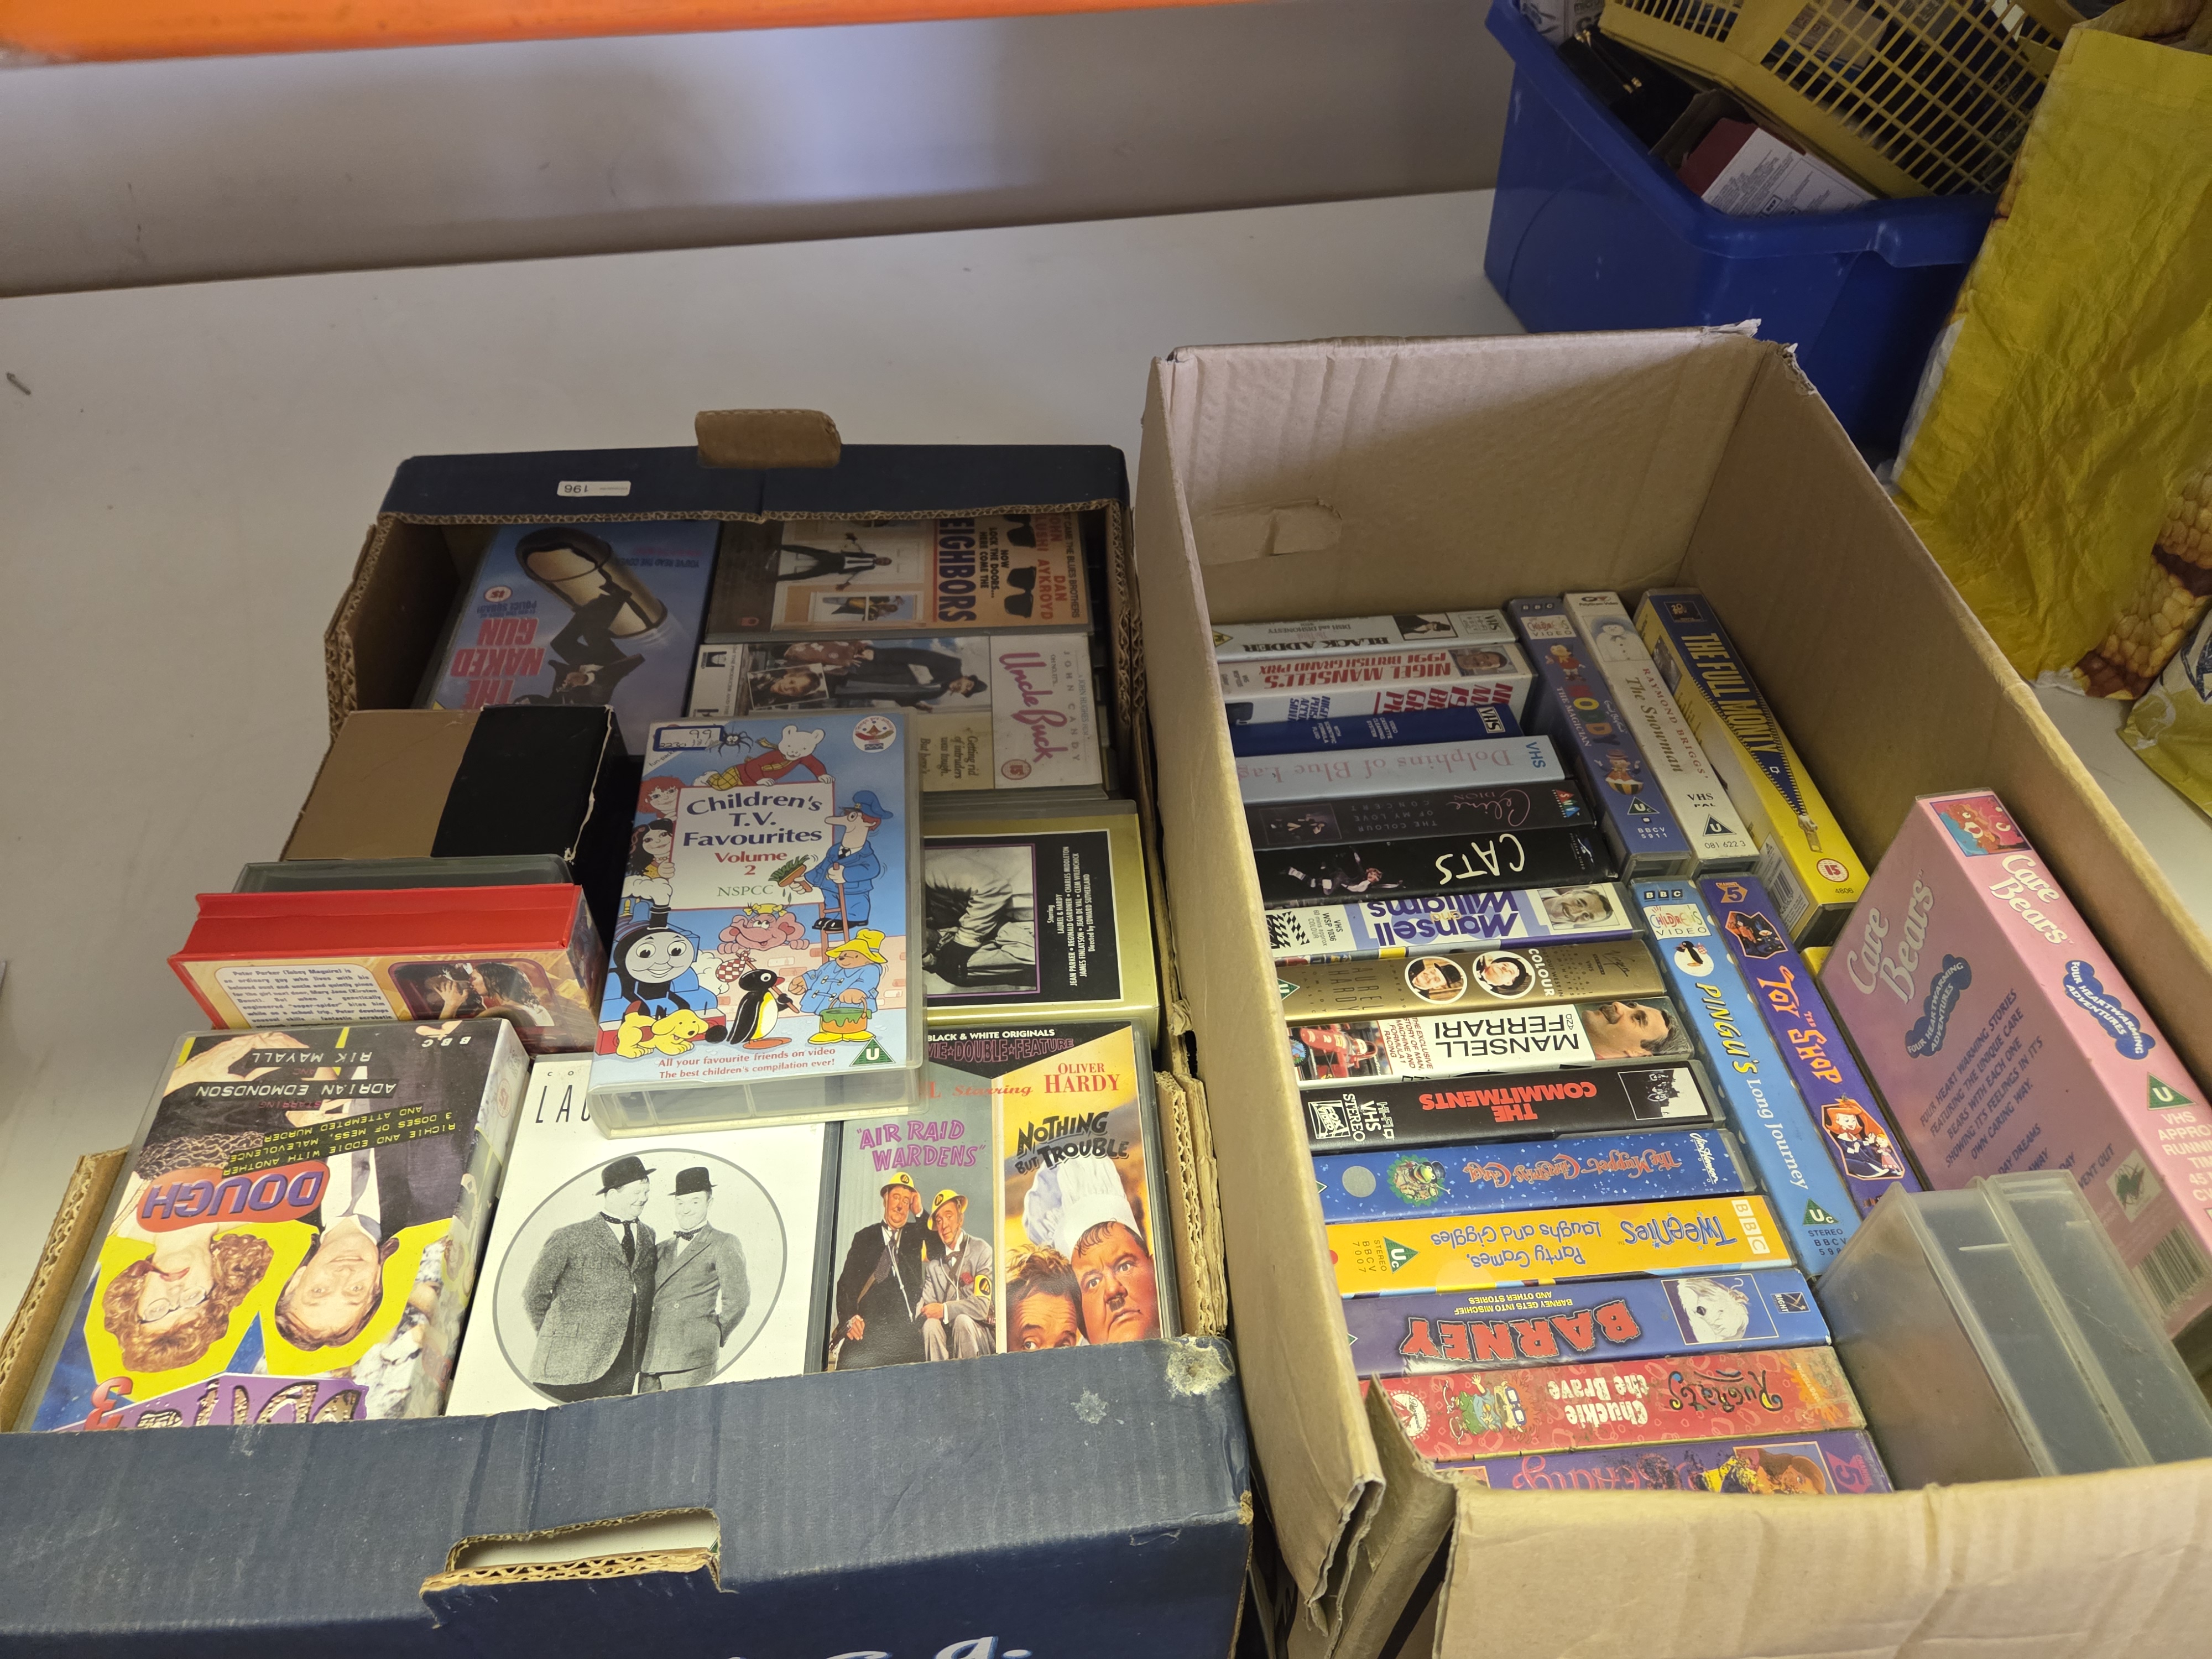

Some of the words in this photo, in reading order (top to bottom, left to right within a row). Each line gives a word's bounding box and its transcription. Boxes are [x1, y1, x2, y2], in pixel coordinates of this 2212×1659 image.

[564, 484, 588, 493] 196
[979, 531, 988, 549] HERE
[980, 551, 989, 572] COME
[1000, 549, 1010, 568] NOW
[938, 518, 977, 622] EIGHBORS
[1037, 559, 1053, 620] AYKROYD
[1053, 575, 1067, 602] DAN
[477, 617, 540, 646] GUN
[1241, 640, 1317, 652] ADDER
[1322, 637, 1390, 649] BLACK
[1681, 633, 1731, 660] THE
[450, 646, 546, 677] NAKED
[1294, 659, 1343, 672] GRAND
[1346, 655, 1402, 667] BRITISH
[1407, 653, 1447, 663] 1991
[999, 652, 1053, 707] Uncle
[1063, 650, 1074, 692] JOHN
[1259, 664, 1291, 675] PRIX
[1264, 666, 1383, 689] MANSELL'S
[1392, 662, 1451, 680] NIGEL
[1695, 662, 1751, 698] FULL
[1642, 667, 1678, 724] RAYMOND
[1389, 720, 1398, 734] VIDEO
[1556, 687, 1570, 705] THE
[1564, 705, 1592, 747] MAGICIAN
[1625, 677, 1646, 701] The
[1640, 704, 1684, 774] Snowman
[1717, 699, 1782, 753] MONTY
[1010, 709, 1068, 763] Buck
[1068, 703, 1081, 761] CANDY
[1380, 717, 1393, 740] CASSETTE
[1364, 755, 1388, 772] of
[1396, 747, 1515, 774] Dolphins
[1525, 740, 1546, 769] VHS
[1294, 760, 1352, 784] Blue
[686, 791, 823, 817] Children's
[1445, 788, 1531, 828] Celine
[728, 811, 777, 827] T.V.
[682, 829, 823, 847] Favourites
[714, 852, 788, 864] Volume
[1062, 846, 1071, 873] MIDDLETON
[1434, 833, 1525, 886] CATS
[743, 864, 757, 876] 2
[2002, 854, 2060, 904] Care
[717, 885, 775, 898] NSPCC
[1064, 873, 1072, 893] CHARLES
[1367, 891, 1519, 917] Williams
[1646, 891, 1682, 899] BBC
[1065, 897, 1074, 922] GARDINER
[1322, 912, 1333, 928] WSP
[1987, 877, 2069, 945] Bears
[1067, 922, 1076, 947] REGINALD
[1307, 918, 1319, 939] COLOUR
[1327, 928, 1337, 942] 1036
[1333, 920, 1344, 933] VHS
[1374, 912, 1519, 947] Mansell
[1656, 926, 1707, 936] VIDEO
[1847, 907, 1890, 995] Care
[1880, 883, 1934, 1004] Bears
[1068, 951, 1077, 973] PARKER
[1528, 948, 1556, 997] COLOUR
[1070, 972, 1078, 987] JEAN
[1328, 970, 1360, 1011] HARDY
[1930, 983, 1954, 1052] ADVENTURES
[2065, 983, 2127, 1035] ADVENTURES
[2070, 961, 2083, 985] FOUR
[2078, 984, 2145, 1055] HEARTWARMING
[1411, 1016, 1421, 1030] THE
[1435, 1014, 1568, 1040] FERRARI
[927, 1033, 957, 1042] BLACK
[969, 1031, 1000, 1040] WHITE
[1001, 1029, 1055, 1039] ORIGINALS
[1383, 1029, 1397, 1058] RACING
[1395, 1019, 1410, 1050] MACHINE
[1406, 1050, 1416, 1069] AND
[1436, 1033, 1580, 1058] MANSELL
[252, 1052, 324, 1063] MAYALL
[335, 1051, 373, 1062] RIK
[658, 1058, 673, 1067] All
[676, 1057, 700, 1069] your
[703, 1054, 750, 1066] favourite
[753, 1050, 789, 1061] friends
[807, 1047, 836, 1056] video
[954, 1040, 1009, 1063] DOUBLE
[1014, 1038, 1074, 1060] FEATURE
[1415, 1030, 1433, 1070] EXCLUSIVE
[659, 1071, 677, 1079] The
[679, 1068, 700, 1078] best
[702, 1065, 749, 1076] children's
[752, 1061, 808, 1073] compilation
[810, 1058, 836, 1067] ever!
[1057, 1062, 1105, 1075] OLIVER
[195, 1085, 309, 1098] EDMONDSON
[321, 1082, 398, 1095] ADRIAN
[952, 1085, 1034, 1097] Starring
[1044, 1073, 1121, 1094] HARDY
[1695, 982, 1759, 1074] PINGU'S
[1746, 1078, 1775, 1120] Long
[1764, 1123, 1809, 1190] Journey
[1418, 1081, 1598, 1111] COMMITMENTS
[398, 1114, 438, 1128] DOSES
[399, 1106, 422, 1116] AND
[445, 1112, 453, 1120] 3
[1316, 1105, 1334, 1131] VIDEO
[1342, 1093, 1366, 1142] STEREO
[1360, 1100, 1382, 1133] VHS
[1494, 1104, 1538, 1123] THE
[2161, 1110, 2198, 1125] VHS
[320, 1112, 392, 1132] ATTEMPTED
[374, 1123, 390, 1132] OF
[408, 1123, 456, 1138] RICHIE
[907, 1119, 965, 1141] RAID
[264, 1127, 314, 1143] MURDER
[330, 1128, 367, 1141] MESS,
[376, 1134, 401, 1145] AND
[1016, 1112, 1110, 1160] NOTHING
[230, 1138, 319, 1163] MALEVOLENCE
[290, 1150, 321, 1163] WITH
[328, 1139, 368, 1154] EDDIE
[1014, 1156, 1041, 1176] BUT
[1035, 1137, 1130, 1170] TROUBLE
[222, 1157, 279, 1176] ANOTHER
[1580, 1149, 1657, 1179] Muppet
[1652, 1150, 1683, 1171] The
[140, 1171, 325, 1220] DOUGH
[1500, 1225, 1534, 1239] and
[1538, 1220, 1603, 1244] Laughs
[1734, 1201, 1768, 1253] BBC
[1808, 1228, 1844, 1238] STEREO
[1431, 1227, 1498, 1250] Giggles
[1374, 1239, 1387, 1272] STEREO
[1466, 1249, 1531, 1268] Games,
[1534, 1244, 1586, 1265] Party
[1468, 1295, 1505, 1305] STORIES
[1506, 1293, 1535, 1302] OTHER
[1515, 1301, 1539, 1310] GETS
[1535, 1291, 1552, 1300] AND
[1540, 1298, 1573, 1307] BARNEY
[1774, 1293, 1789, 1313] RIGHT
[1454, 1306, 1494, 1315] MISCHIEF
[1494, 1303, 1515, 1312] INTO
[1400, 1299, 1641, 1361] BARNEY
[1547, 1376, 1609, 1401] Brave
[1613, 1374, 1650, 1398] the
[1564, 1400, 1649, 1428] Chuckie
